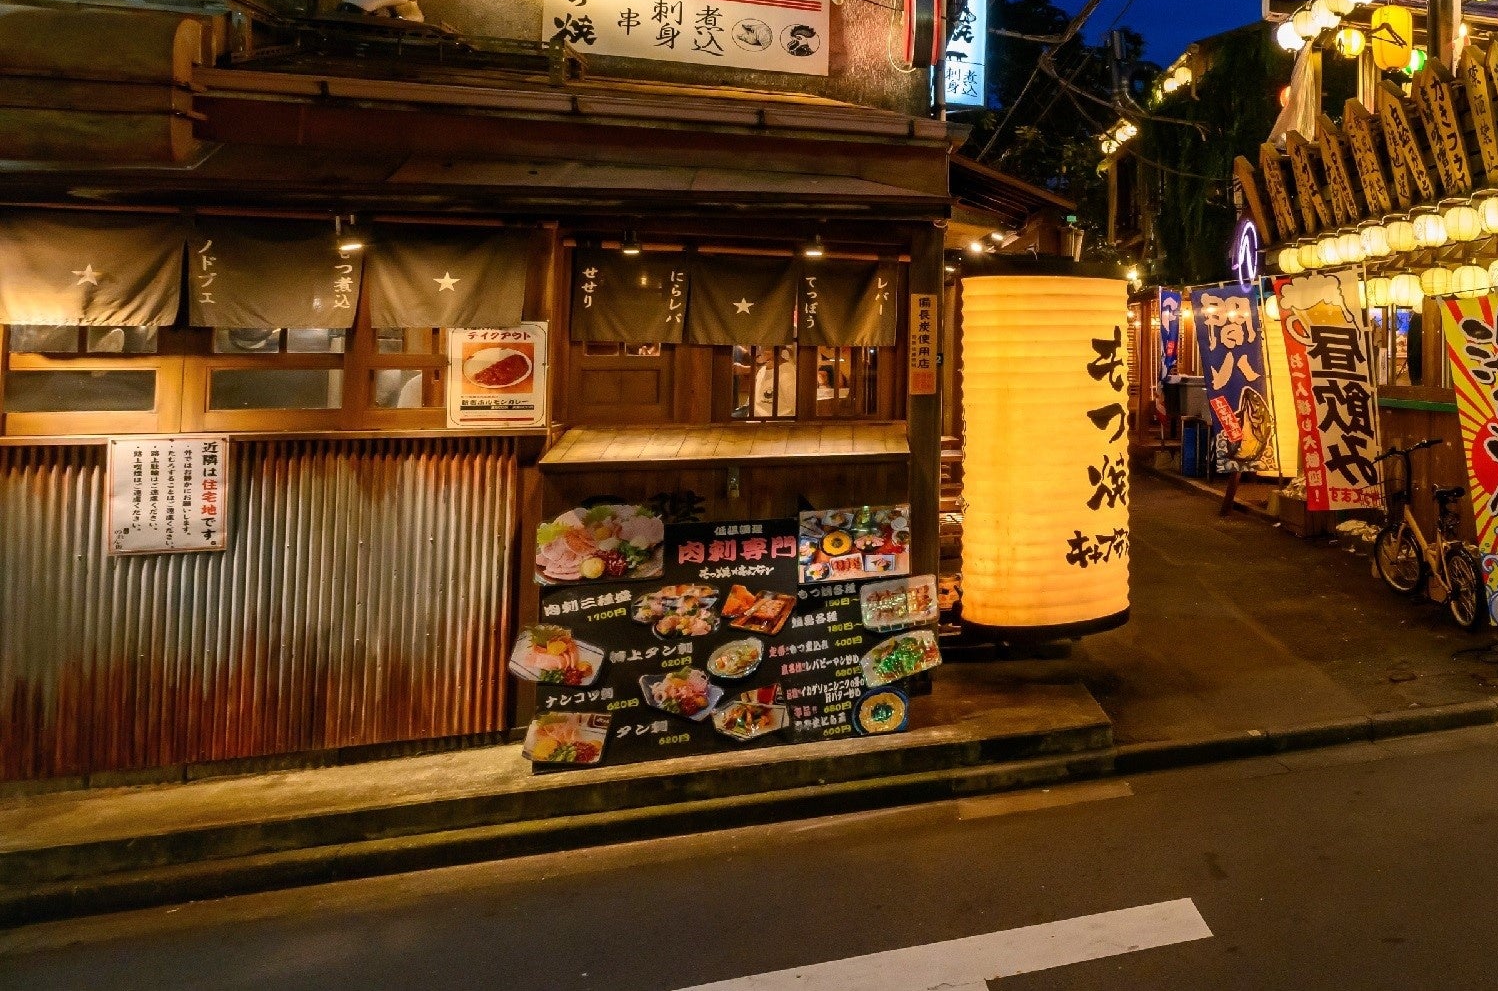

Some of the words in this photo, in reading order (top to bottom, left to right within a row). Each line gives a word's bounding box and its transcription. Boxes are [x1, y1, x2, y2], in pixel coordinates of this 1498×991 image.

[617, 7, 642, 36] 串
[691, 4, 725, 57] 煮込
[581, 267, 599, 309] せせり
[665, 270, 685, 324] にらレバ
[875, 276, 889, 316] レバー
[467, 331, 532, 341] テイクアウト
[1086, 325, 1127, 511] もつ焼
[201, 441, 219, 546] 近隣は住宅地です。
[677, 535, 797, 565] 肉刺専門
